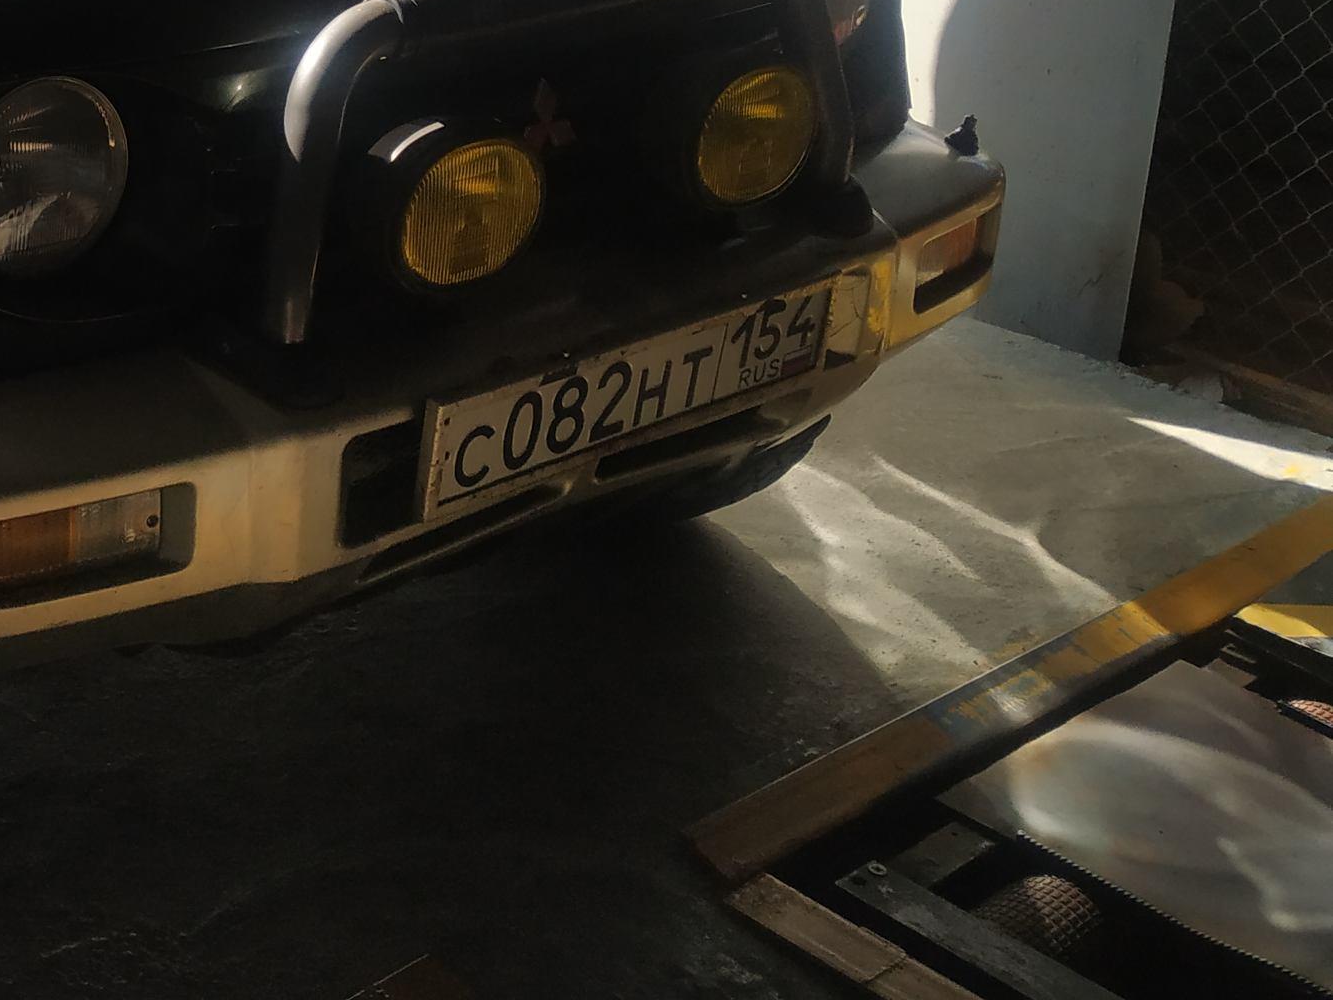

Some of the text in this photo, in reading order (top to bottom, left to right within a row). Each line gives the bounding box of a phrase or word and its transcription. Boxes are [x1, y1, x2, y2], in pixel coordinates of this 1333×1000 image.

[454, 296, 818, 488] С082НТ 154
[738, 357, 783, 388] RUS
